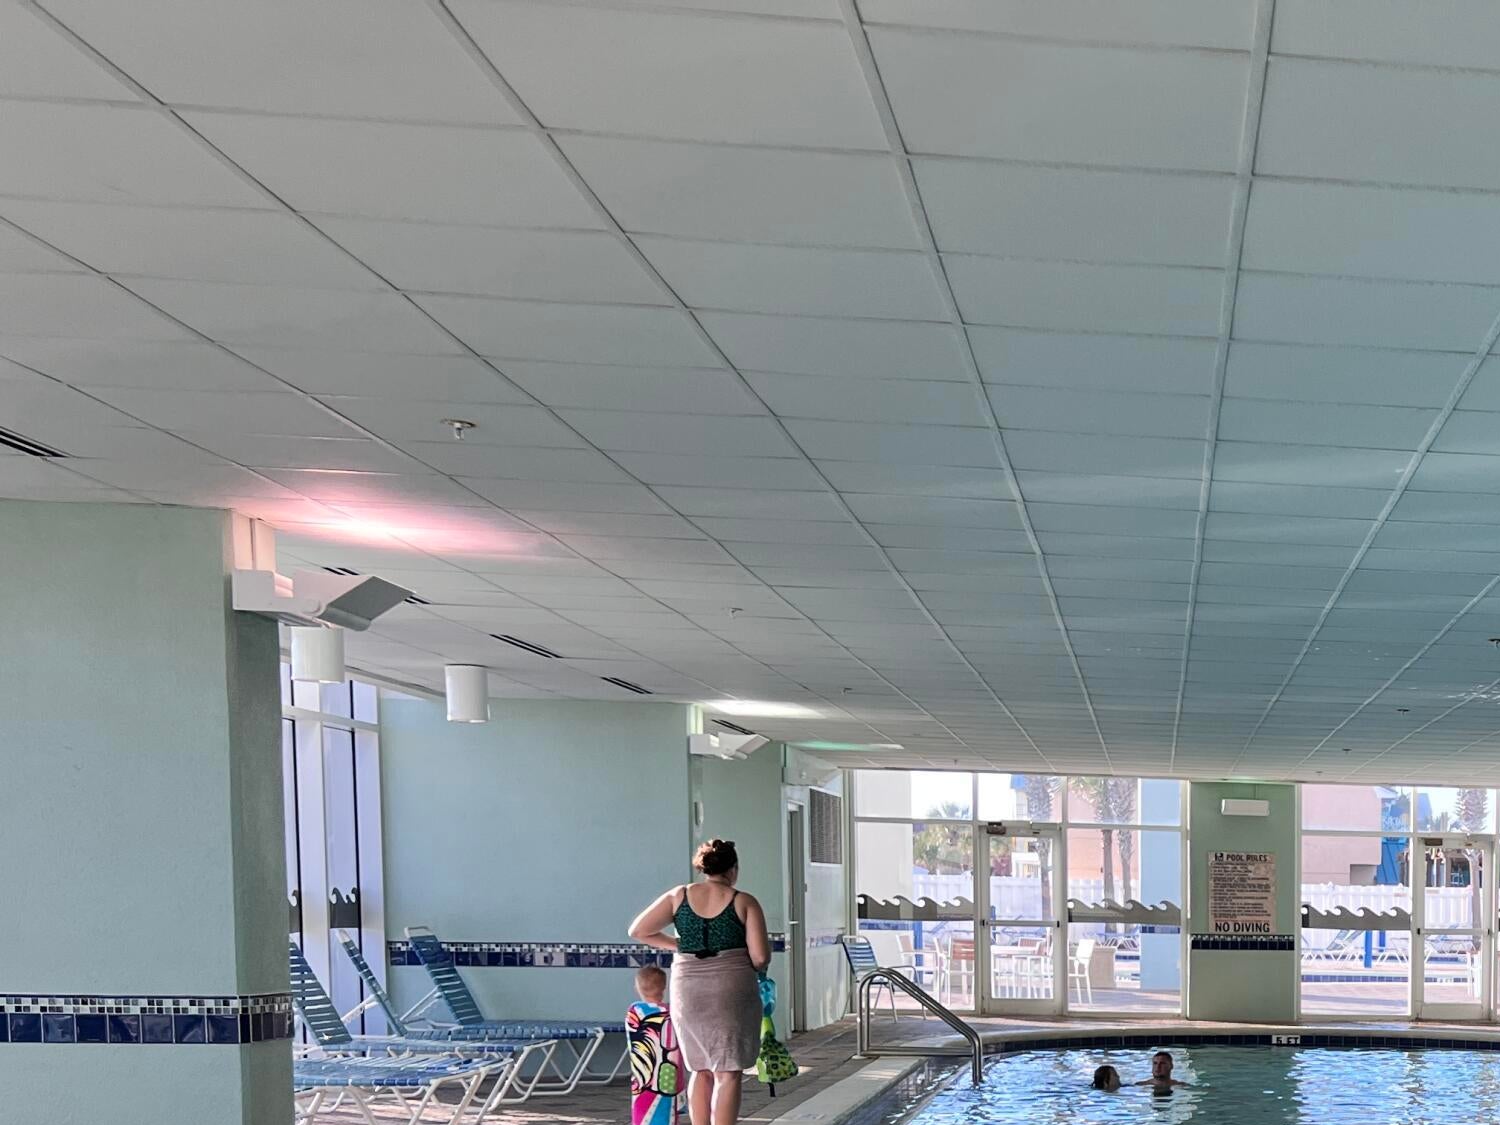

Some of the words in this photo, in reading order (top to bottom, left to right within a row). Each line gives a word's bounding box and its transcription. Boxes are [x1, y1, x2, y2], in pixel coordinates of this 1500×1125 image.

[1246, 854, 1268, 862] RULES
[1215, 922, 1230, 932] NO
[1233, 922, 1270, 933] DIVING
[1287, 1036, 1299, 1045] FT
